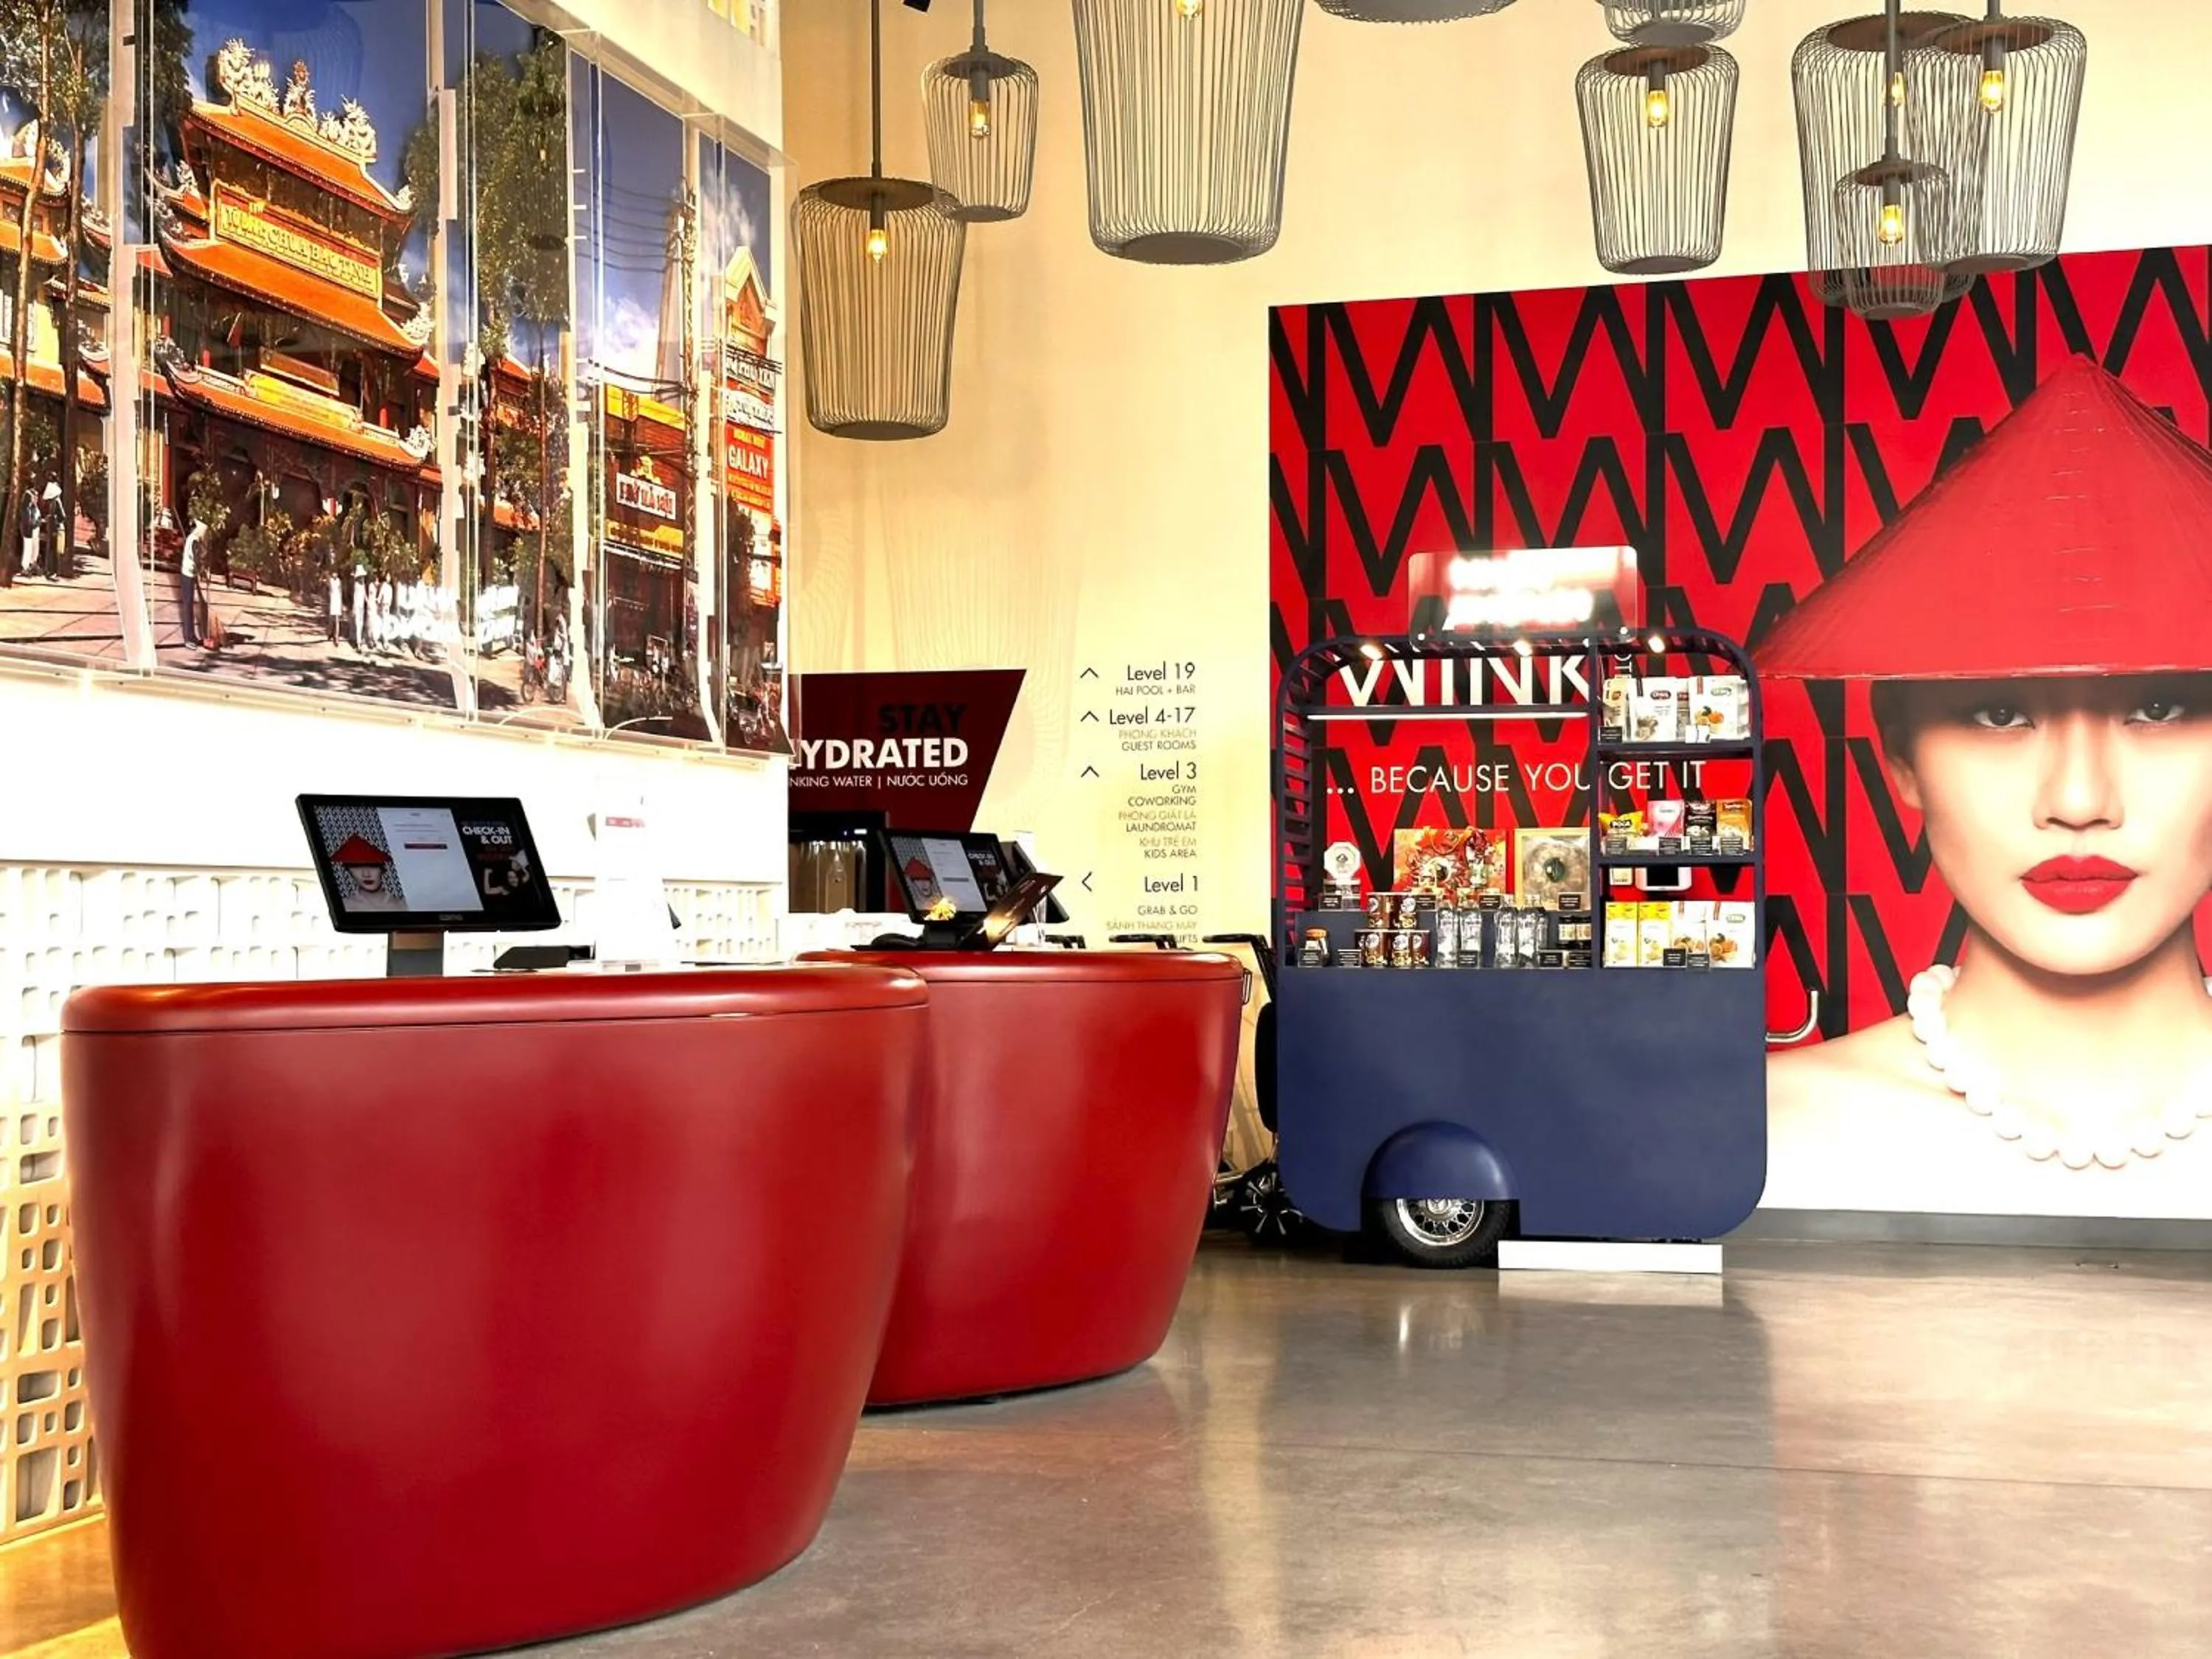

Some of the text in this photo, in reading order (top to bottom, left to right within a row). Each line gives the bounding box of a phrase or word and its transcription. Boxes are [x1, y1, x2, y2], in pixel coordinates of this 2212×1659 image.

[728, 445, 769, 479] GALAXY
[1127, 661, 1195, 681] Level 19
[1136, 684, 1164, 695] POOL
[1176, 684, 1196, 695] BAR
[878, 703, 967, 734] STAY
[1109, 705, 1196, 725] Level 4-17
[1121, 740, 1197, 751] GUEST ROOMS
[790, 737, 969, 770] YDRATED
[1140, 760, 1197, 781] Level 3
[832, 775, 873, 787] WATER
[1370, 763, 1510, 794] BECAUSE
[1608, 760, 1669, 790] GET
[1683, 760, 1707, 789] IT
[1172, 784, 1197, 794] GYM
[1127, 796, 1197, 807] COWORKING
[462, 824, 510, 836] CHECK-IN
[1126, 821, 1197, 832] LAUNDROMAT
[491, 835, 513, 844] OUT
[1144, 849, 1197, 859] KIDS AREA
[1144, 872, 1198, 893] Level 1
[1137, 905, 1198, 916] GRAB & GO
